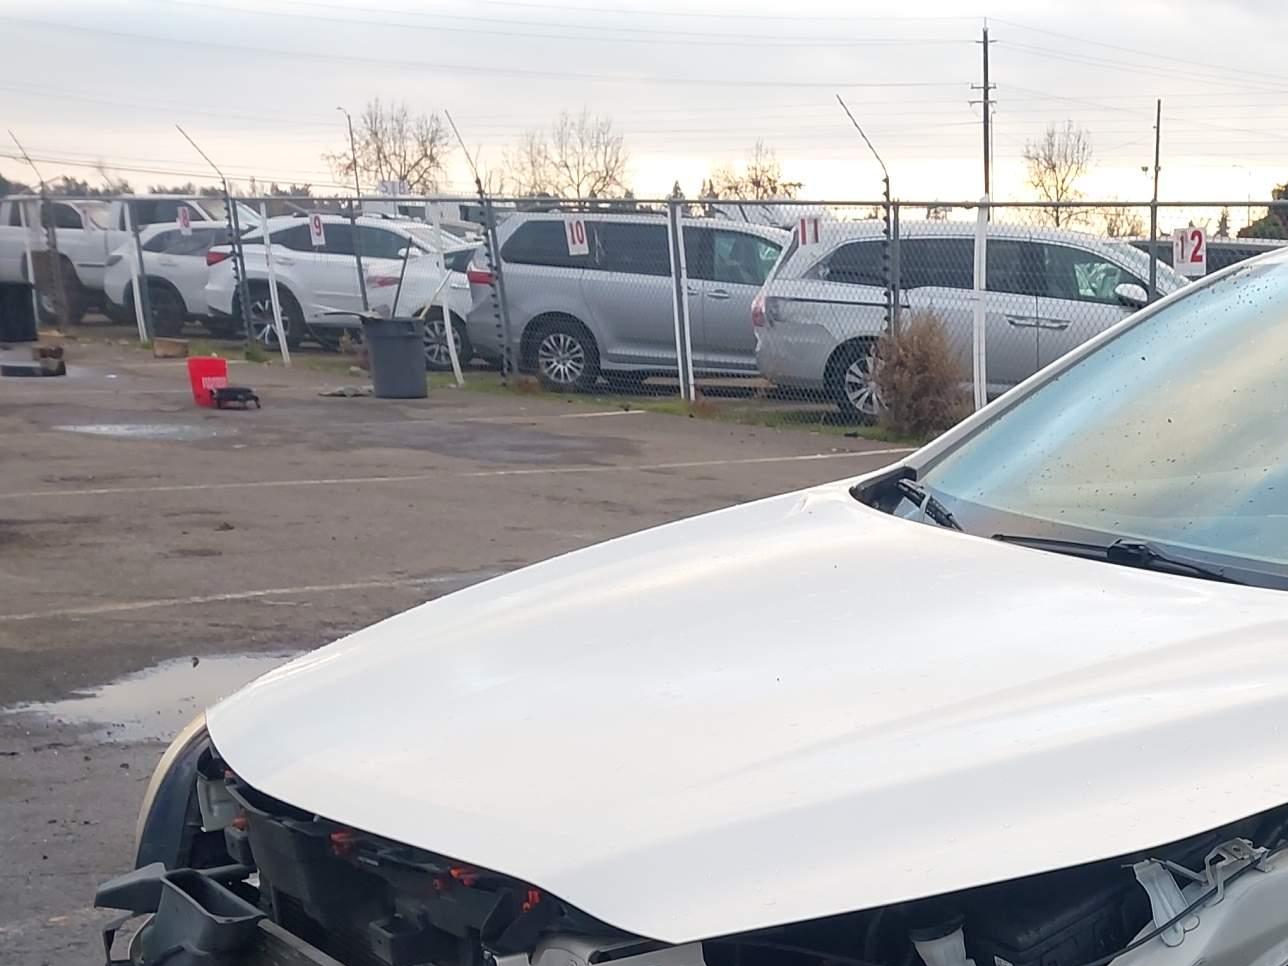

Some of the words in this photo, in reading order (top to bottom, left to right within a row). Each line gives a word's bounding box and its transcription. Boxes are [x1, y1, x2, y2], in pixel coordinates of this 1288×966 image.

[313, 215, 322, 237] 9
[569, 220, 585, 246] 10
[800, 218, 819, 246] 11
[1179, 229, 1204, 264] 12
